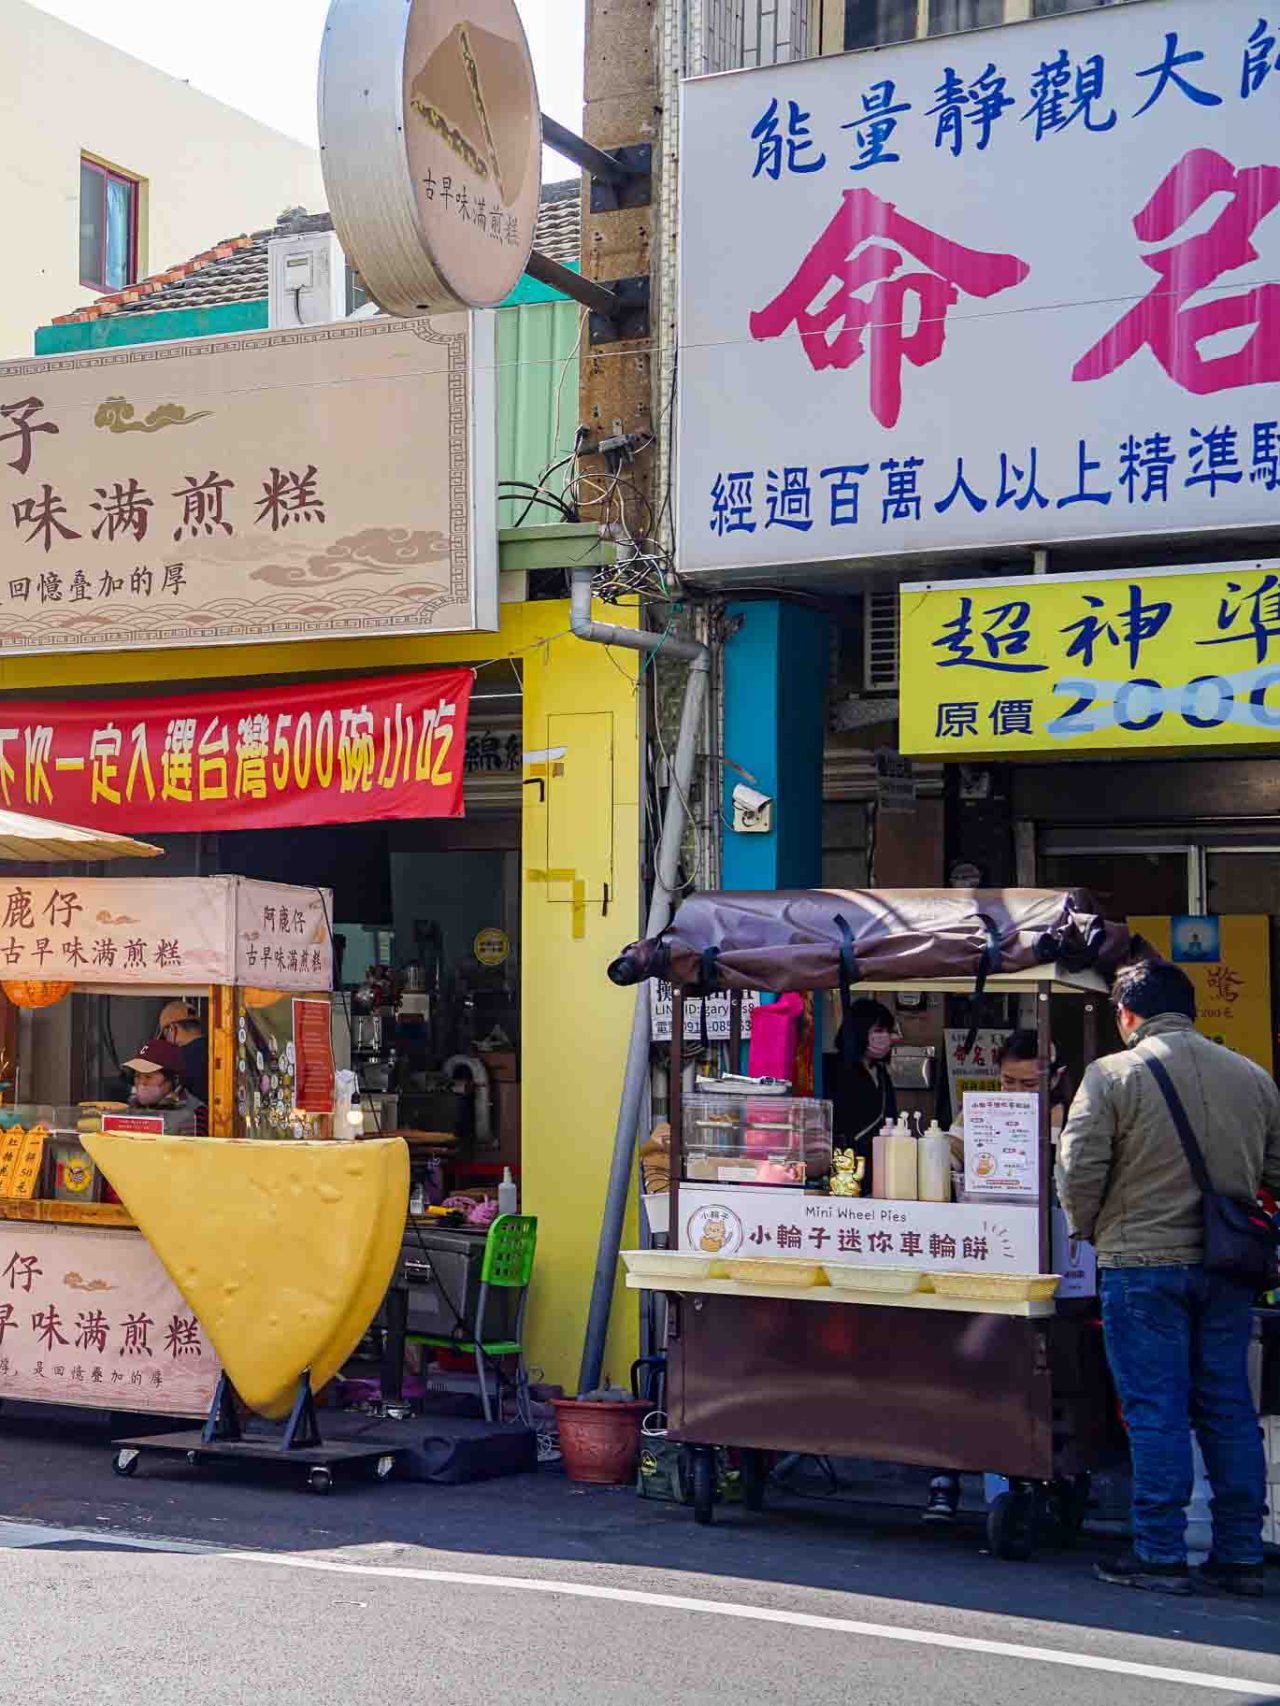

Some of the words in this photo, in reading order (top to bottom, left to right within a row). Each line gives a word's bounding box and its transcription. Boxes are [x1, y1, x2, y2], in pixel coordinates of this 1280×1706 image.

[749, 147, 1280, 430] 命名
[931, 574, 1280, 675] 超神準
[934, 699, 1035, 739] 原價
[264, 905, 306, 935] 阿鹿仔
[806, 1206, 833, 1219] Mini
[838, 1207, 875, 1221] Wheel
[881, 1209, 907, 1224] Pies
[749, 1224, 990, 1261] 小輪子迷你車輪餅
